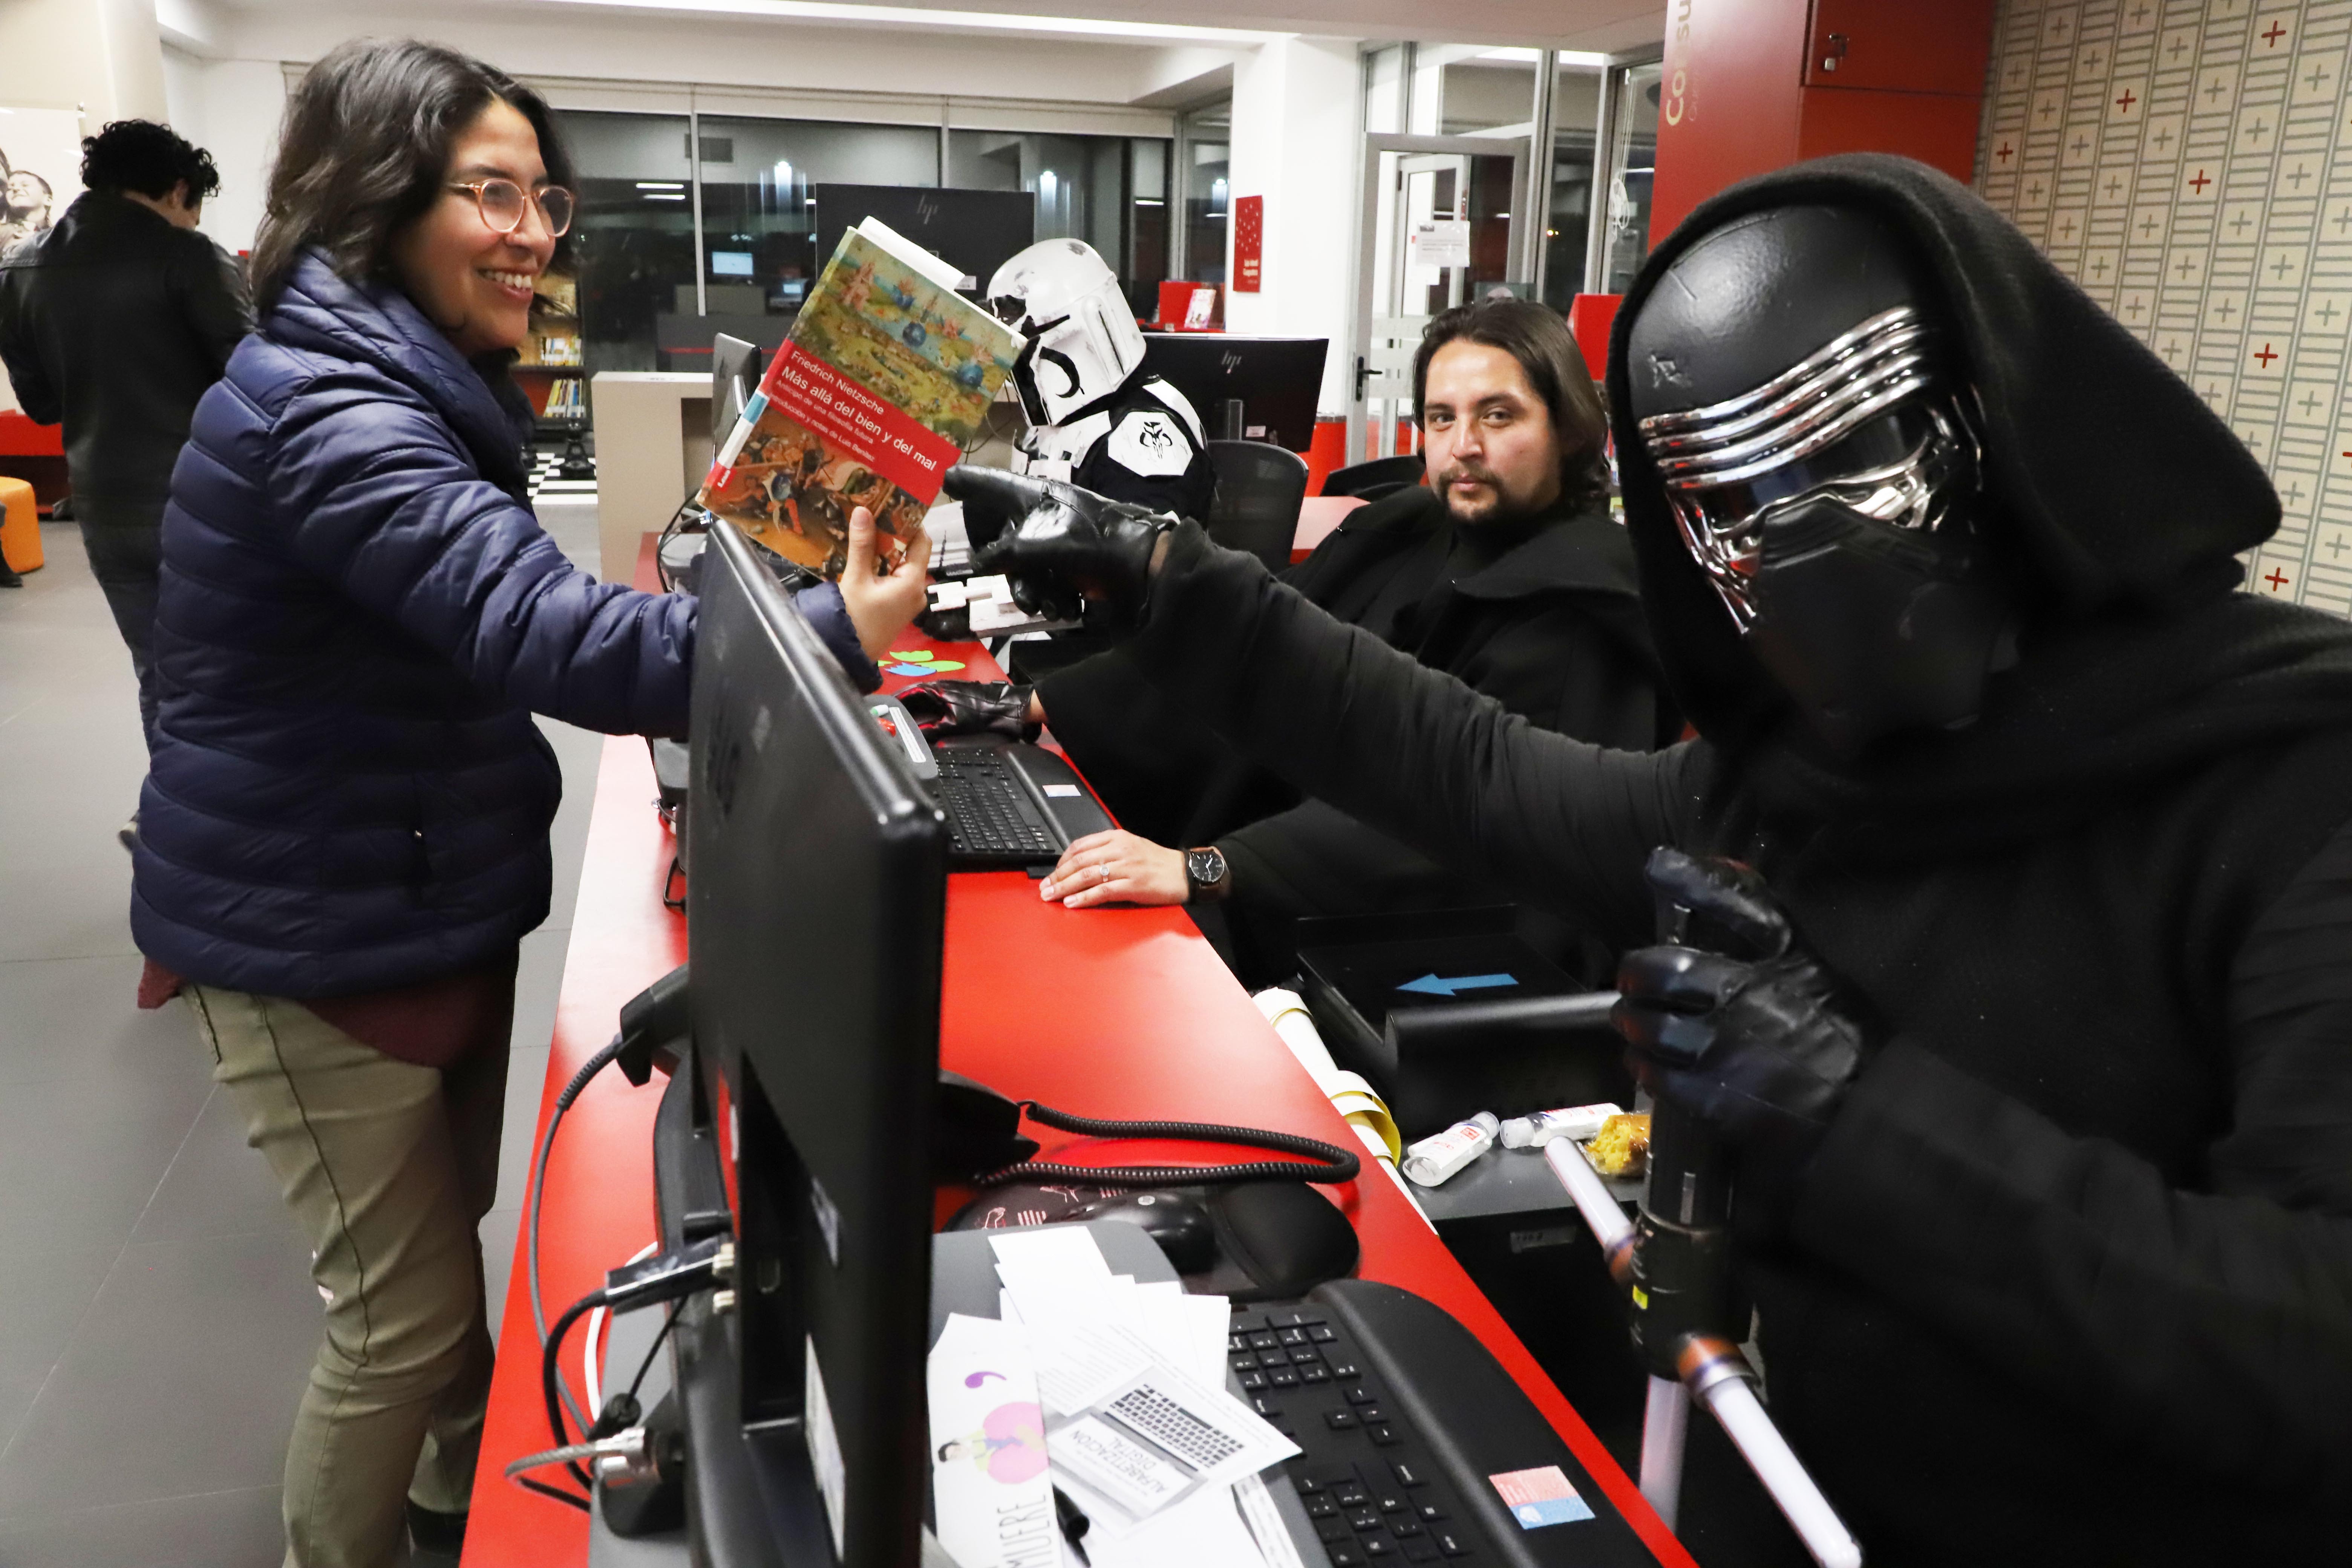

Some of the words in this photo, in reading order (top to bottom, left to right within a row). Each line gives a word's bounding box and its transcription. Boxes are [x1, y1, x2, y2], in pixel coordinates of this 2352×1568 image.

[1666, 0, 1692, 126] Cosu
[792, 351, 834, 383] Friedrich
[836, 378, 884, 415] Nietzsche
[1222, 349, 1242, 374] hp
[782, 366, 808, 389] Más
[810, 386, 832, 404] allá
[835, 401, 855, 418] del
[855, 412, 881, 435] bien
[882, 432, 892, 443] y
[893, 439, 913, 455] del
[913, 452, 937, 471] mal
[804, 397, 812, 406] de
[814, 404, 826, 414] una
[854, 428, 873, 444] futura
[811, 420, 828, 433] notas
[829, 430, 838, 439] de
[838, 435, 851, 447] Luis
[1110, 1437, 1156, 1470] DIGITAL
